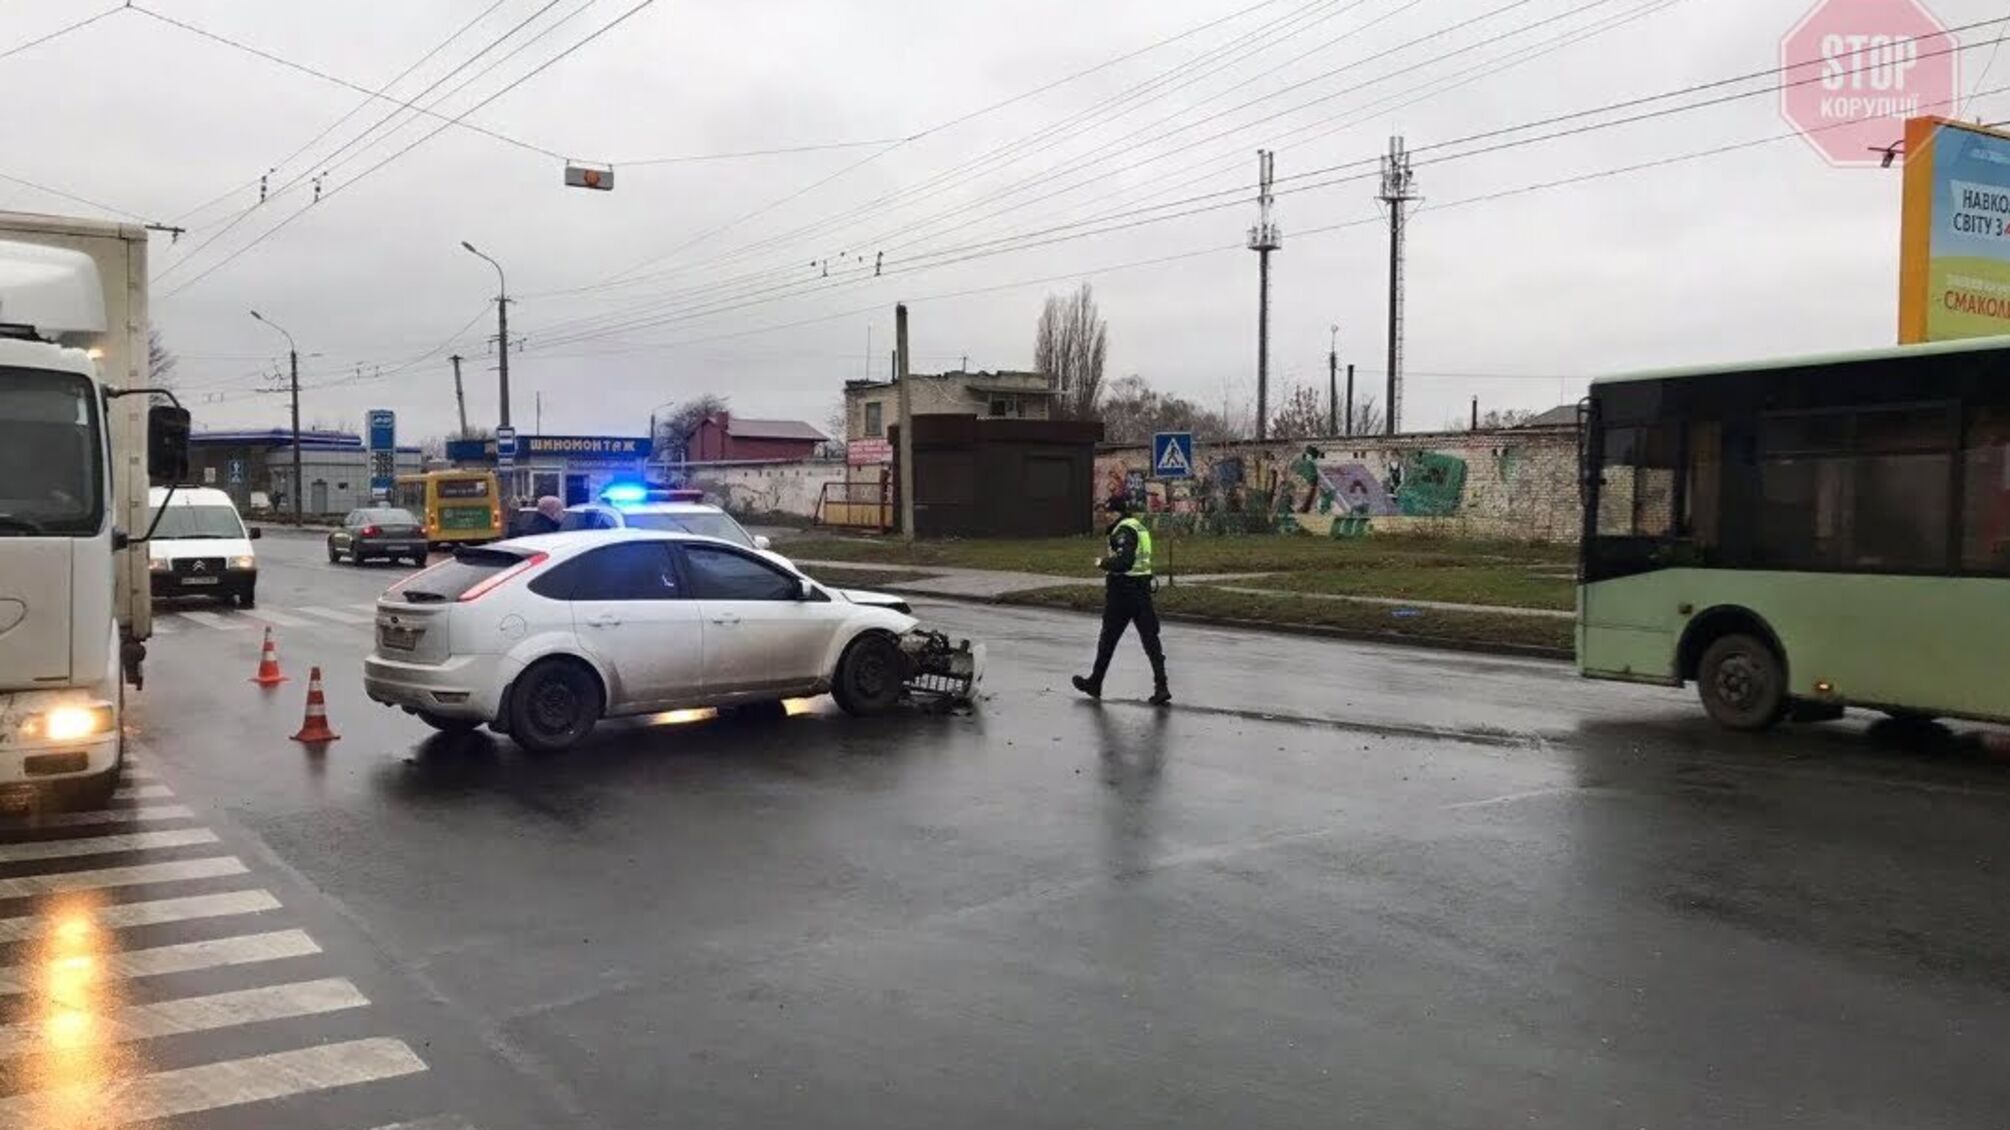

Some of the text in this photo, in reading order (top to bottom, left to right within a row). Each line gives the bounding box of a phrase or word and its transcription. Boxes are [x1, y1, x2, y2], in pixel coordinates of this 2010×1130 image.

[1962, 188, 2010, 214] НАВКО
[1953, 212, 1992, 235] СВІТУ
[1944, 290, 2010, 320] СМАКОЛ
[530, 438, 636, 453] ШИНОМОНТАЖ
